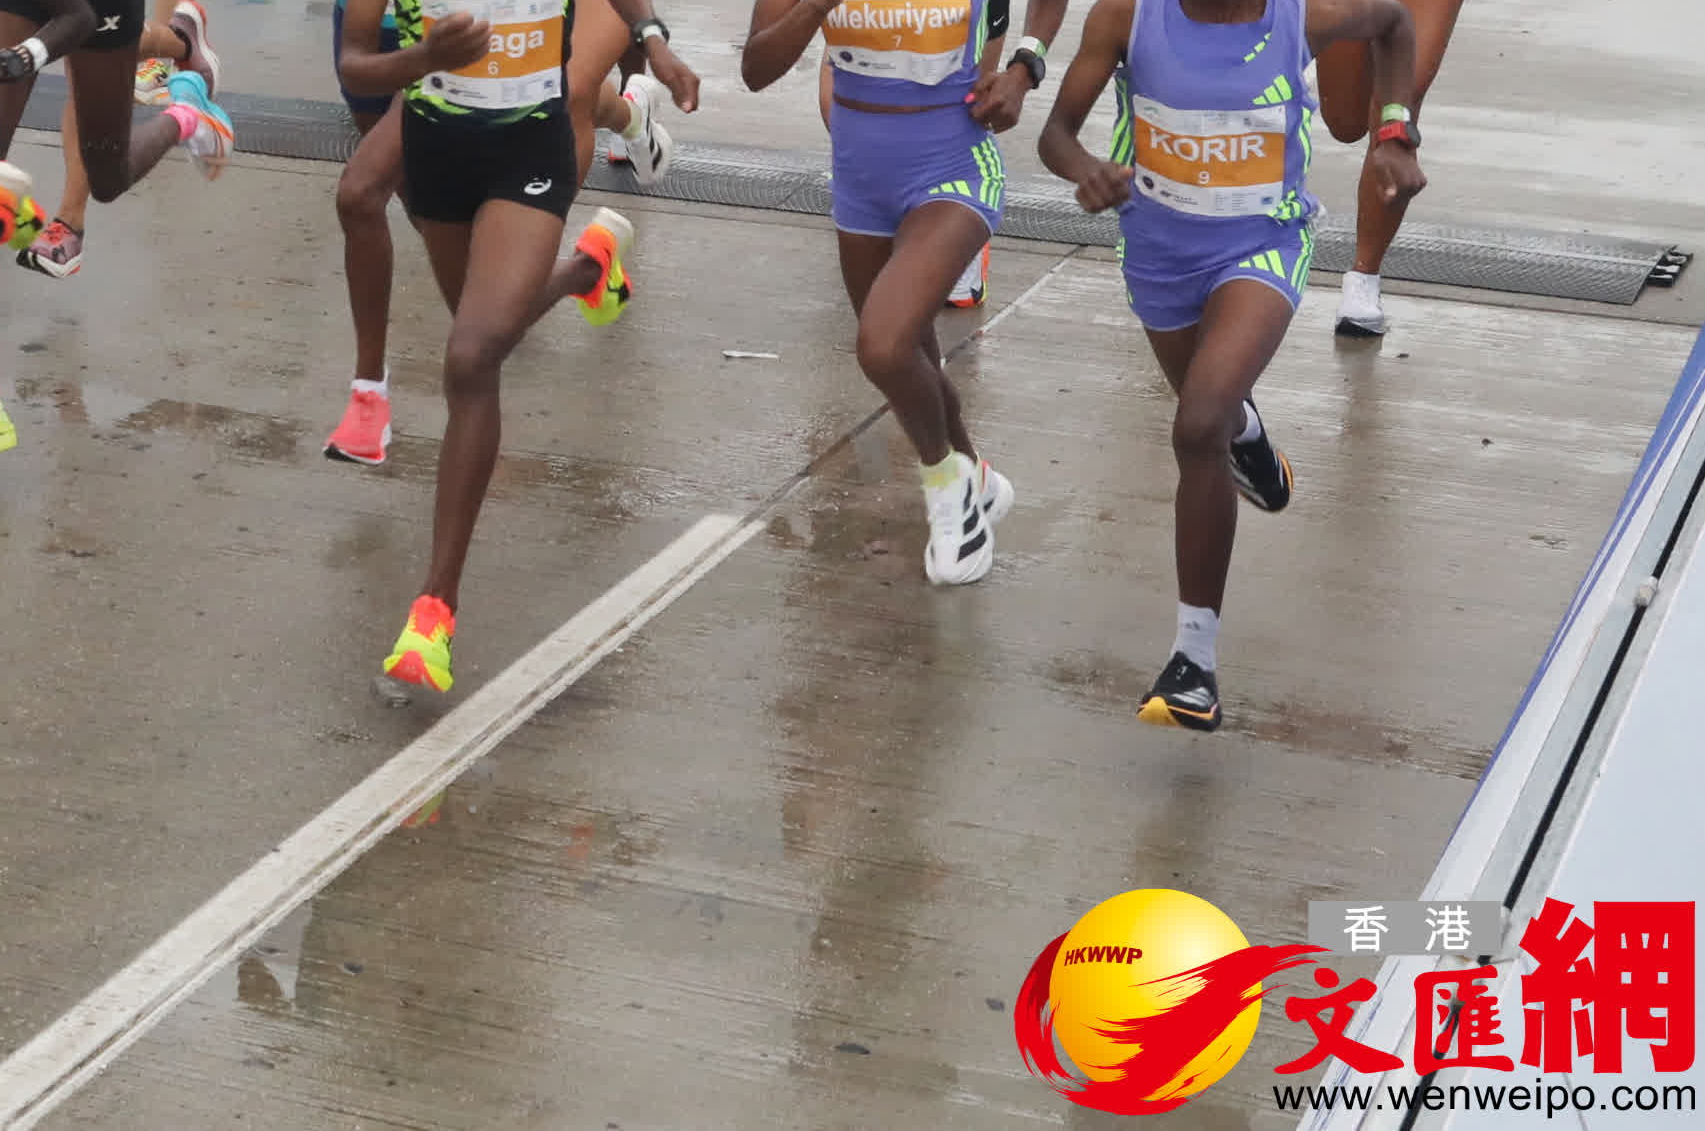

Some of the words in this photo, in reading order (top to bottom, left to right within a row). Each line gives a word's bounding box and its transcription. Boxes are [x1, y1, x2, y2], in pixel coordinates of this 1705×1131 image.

[827, 1, 966, 35] Mekuriyaw
[489, 30, 545, 58] aga
[893, 35, 903, 48] 7
[488, 61, 499, 76] 6
[1149, 128, 1266, 163] KORIR
[1199, 171, 1210, 185] 9
